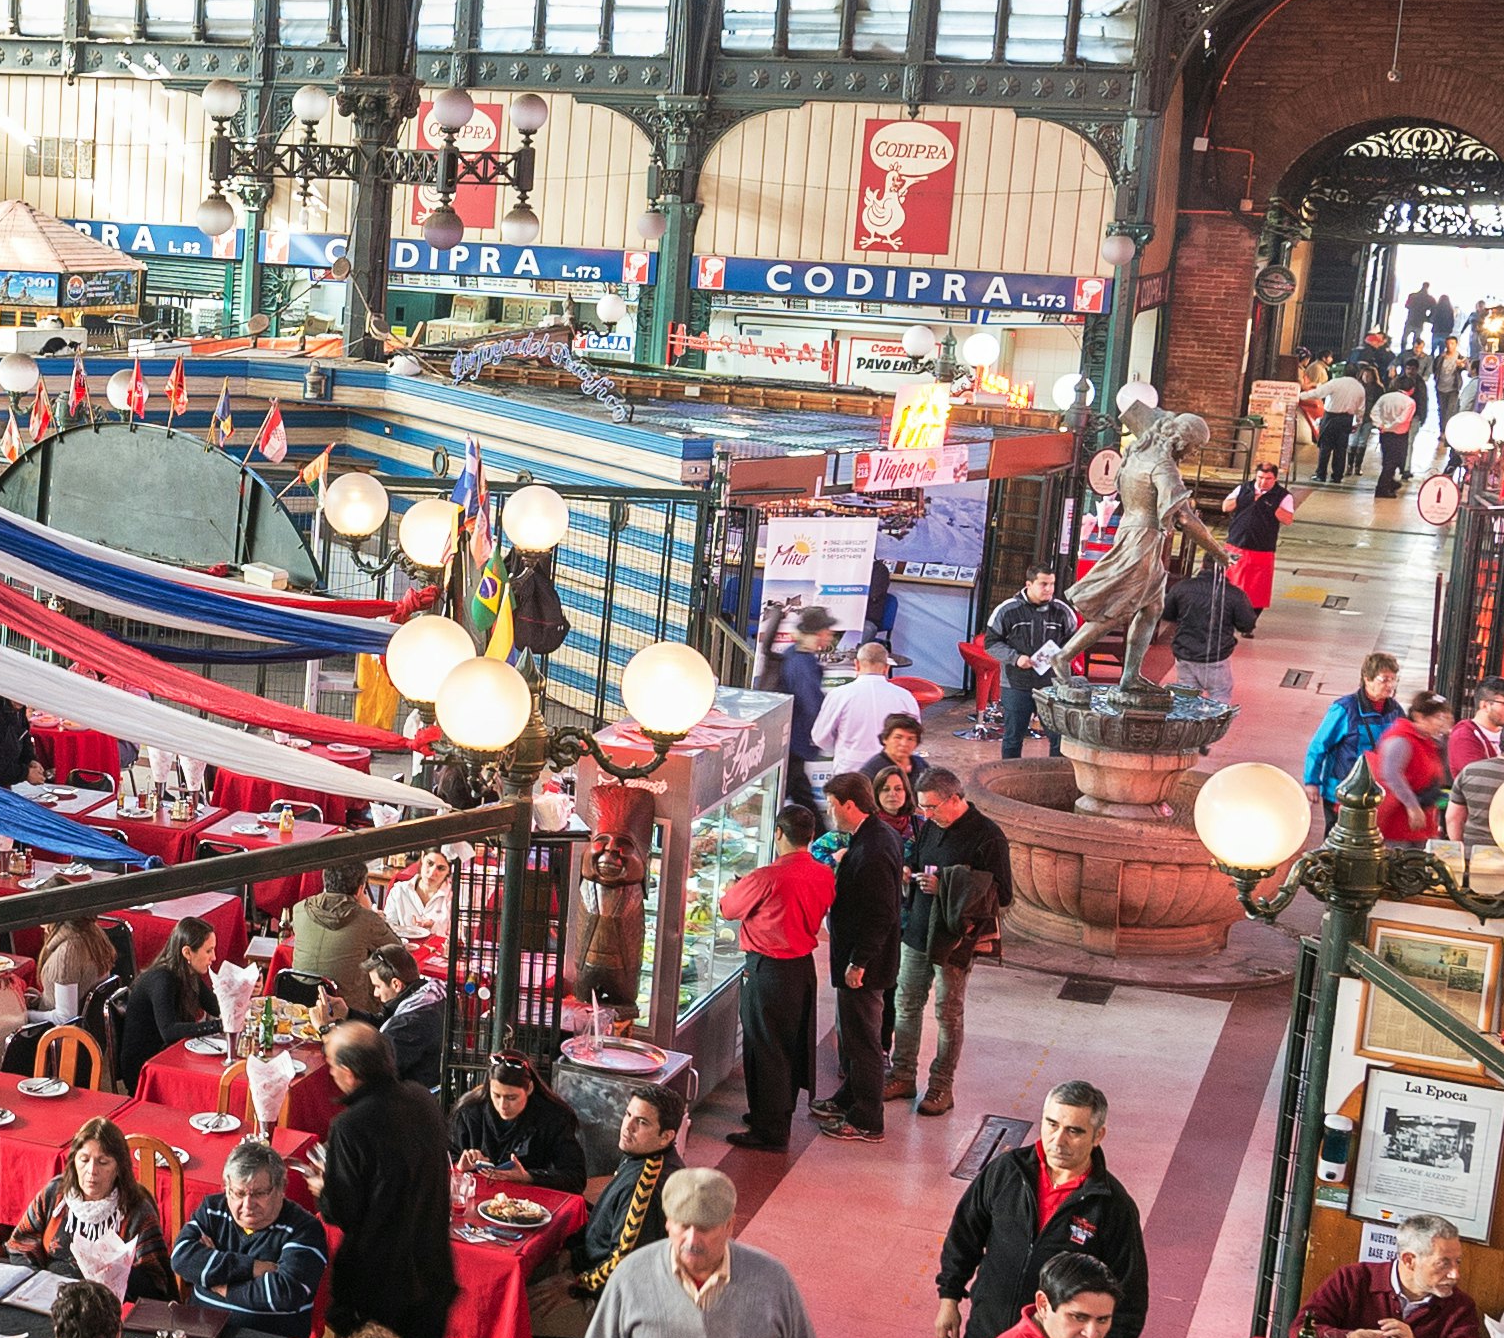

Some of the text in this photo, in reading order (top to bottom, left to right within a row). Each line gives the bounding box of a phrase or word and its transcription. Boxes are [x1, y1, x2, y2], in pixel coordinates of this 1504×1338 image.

[874, 140, 948, 160] CODIPRA
[765, 263, 1013, 307] CODIPRA
[586, 334, 631, 351] CAJA
[856, 357, 892, 371] PAVO
[873, 457, 915, 488] Viajes
[770, 544, 811, 566] Mitur
[1405, 1080, 1468, 1104] La Epoca
